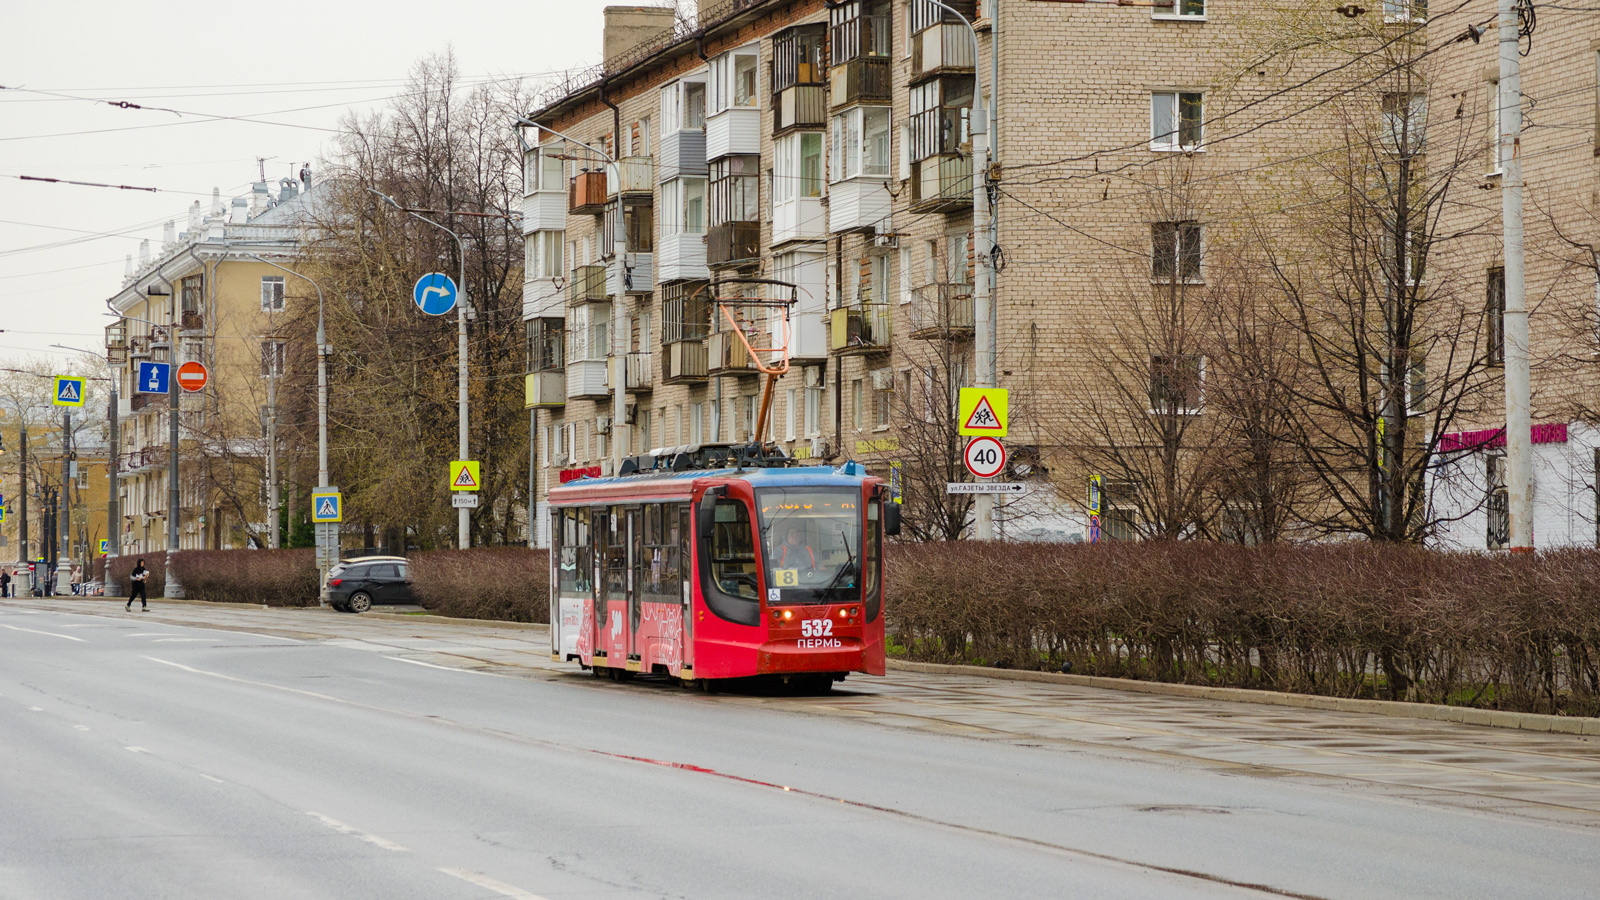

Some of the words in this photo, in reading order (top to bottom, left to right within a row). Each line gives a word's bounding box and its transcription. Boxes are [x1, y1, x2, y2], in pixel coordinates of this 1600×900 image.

[973, 449, 997, 465] 40
[783, 571, 794, 584] 8
[801, 619, 833, 637] 532
[797, 639, 842, 648] ПЕРМЬ
